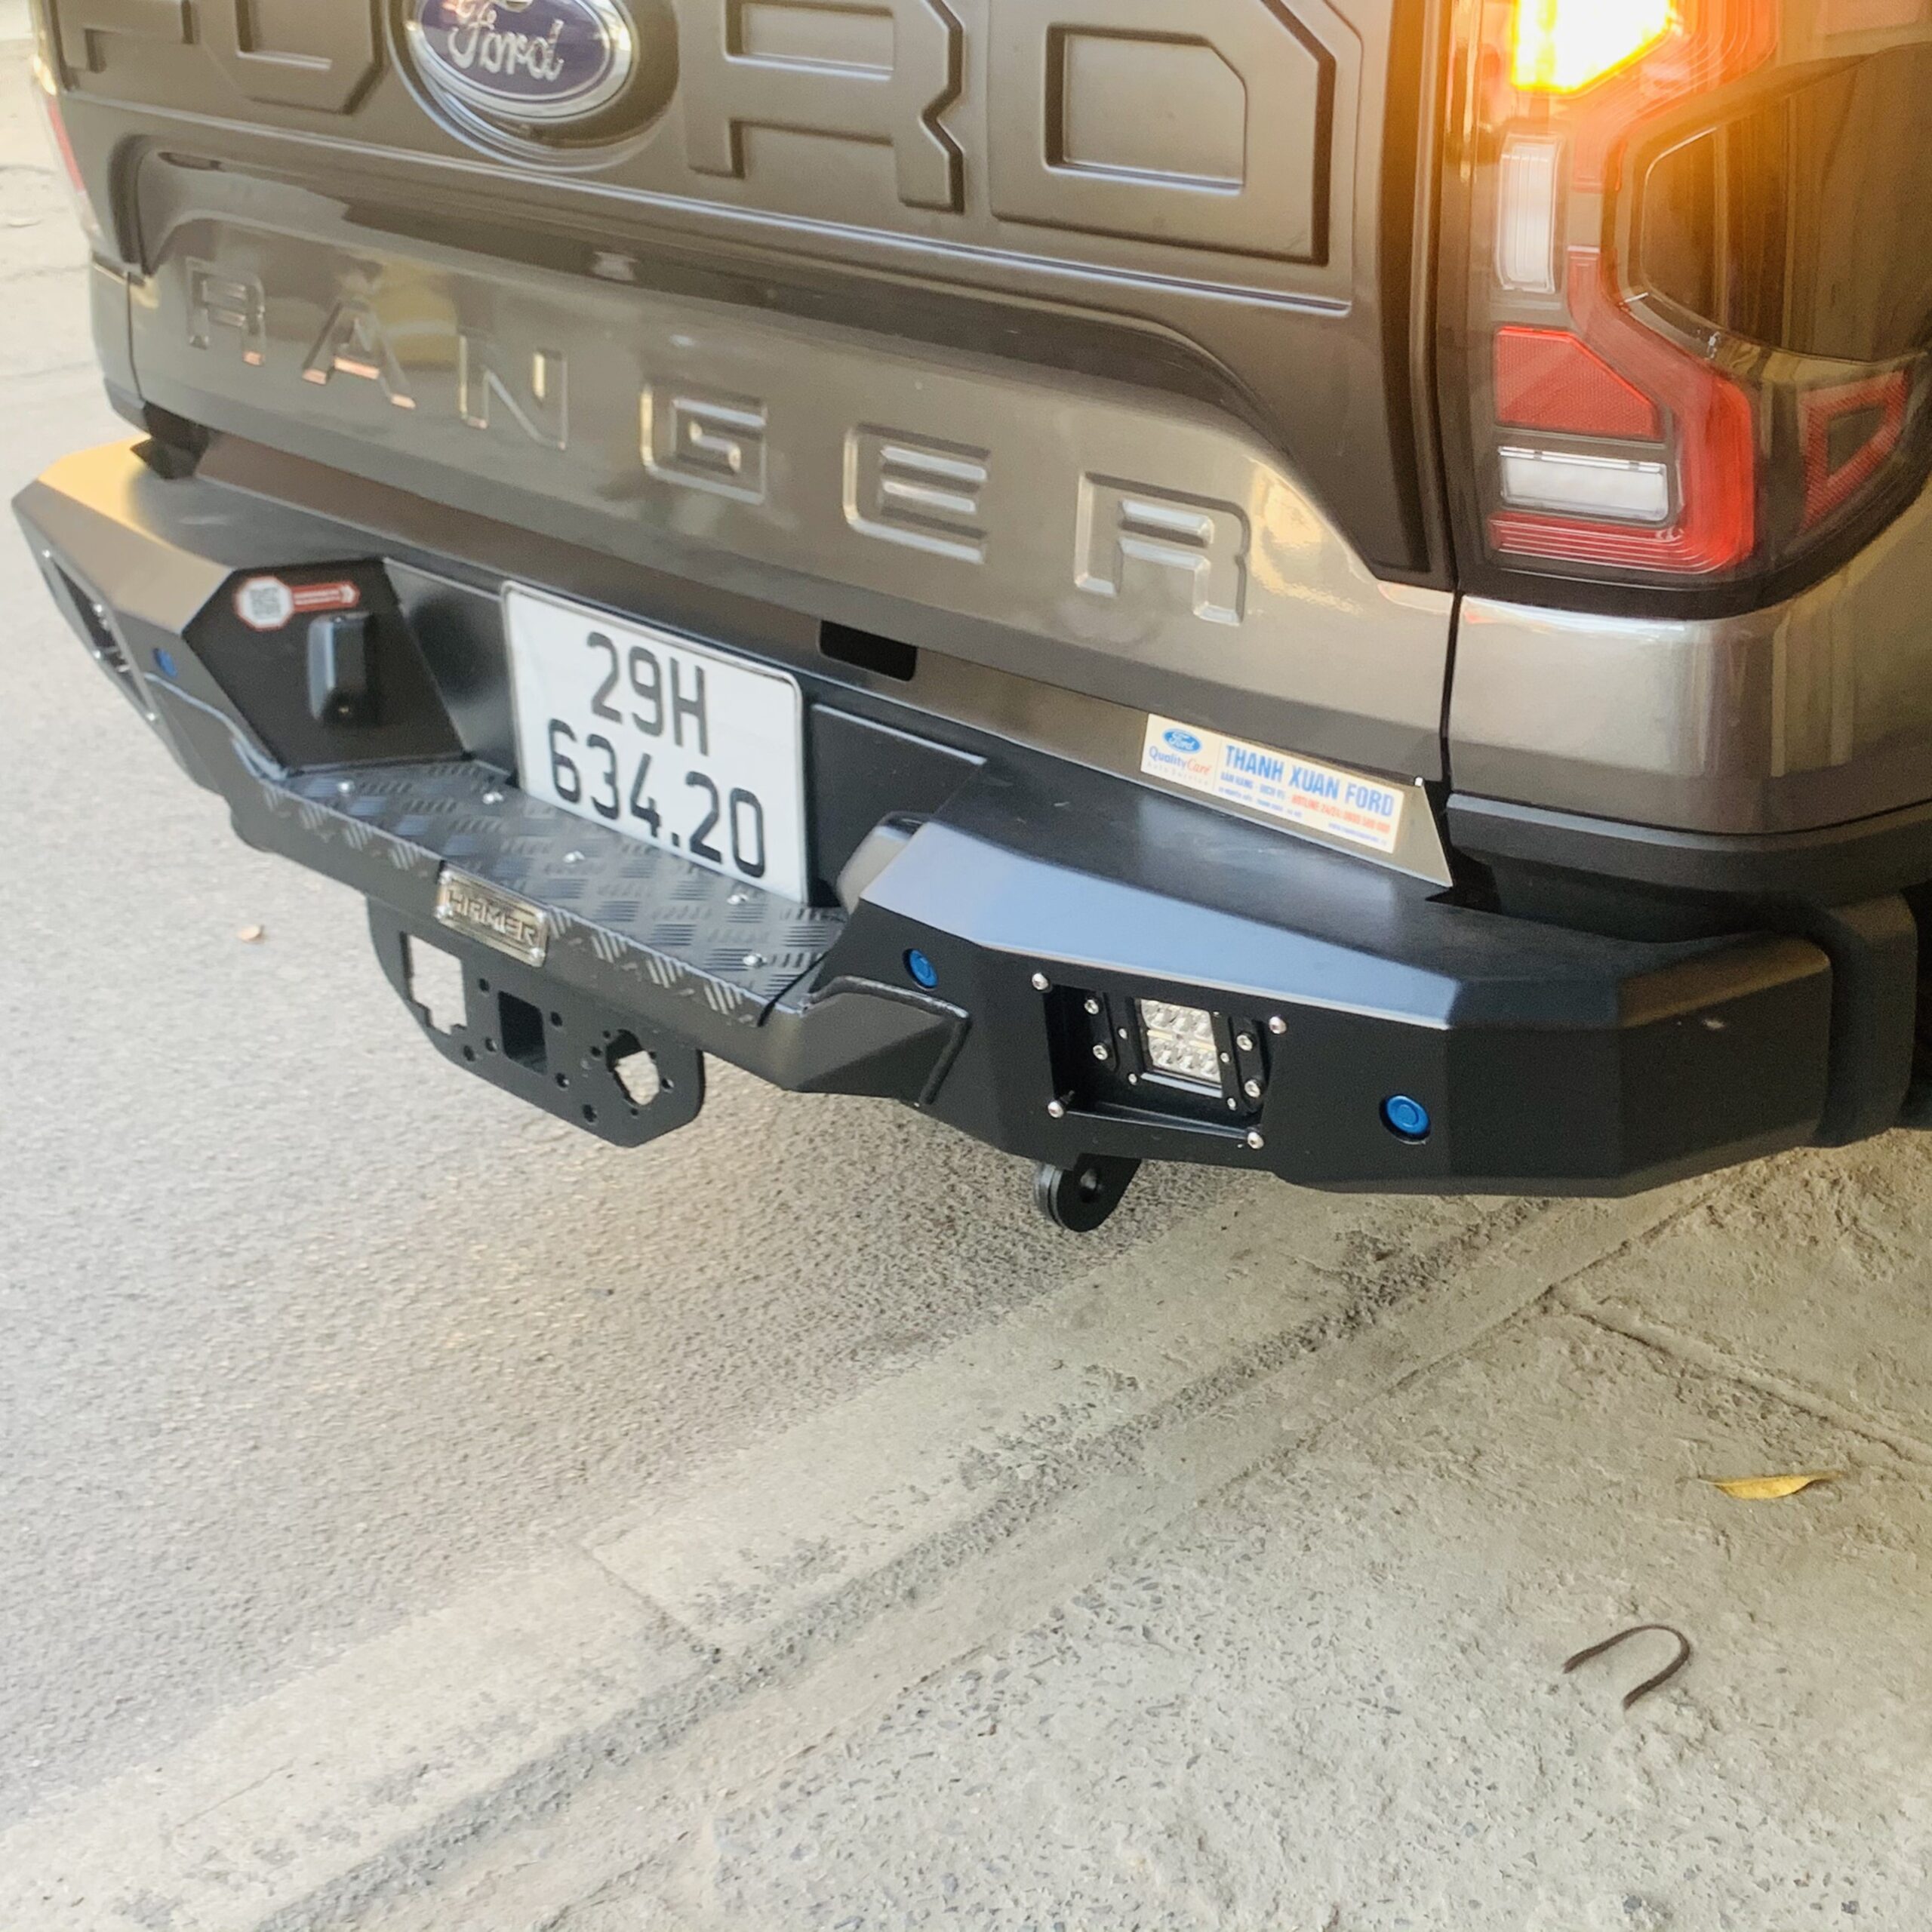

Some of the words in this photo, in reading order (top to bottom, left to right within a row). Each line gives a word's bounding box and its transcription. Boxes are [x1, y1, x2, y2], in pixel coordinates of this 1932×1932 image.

[448, 0, 565, 82] Ford
[186, 255, 1250, 626] RANGER
[586, 631, 709, 756] 29H
[1166, 731, 1198, 750] Ford
[548, 718, 766, 878] 634.20
[1226, 744, 1284, 783] THANH
[1288, 764, 1340, 800] XUAN
[1344, 782, 1395, 817] FORD
